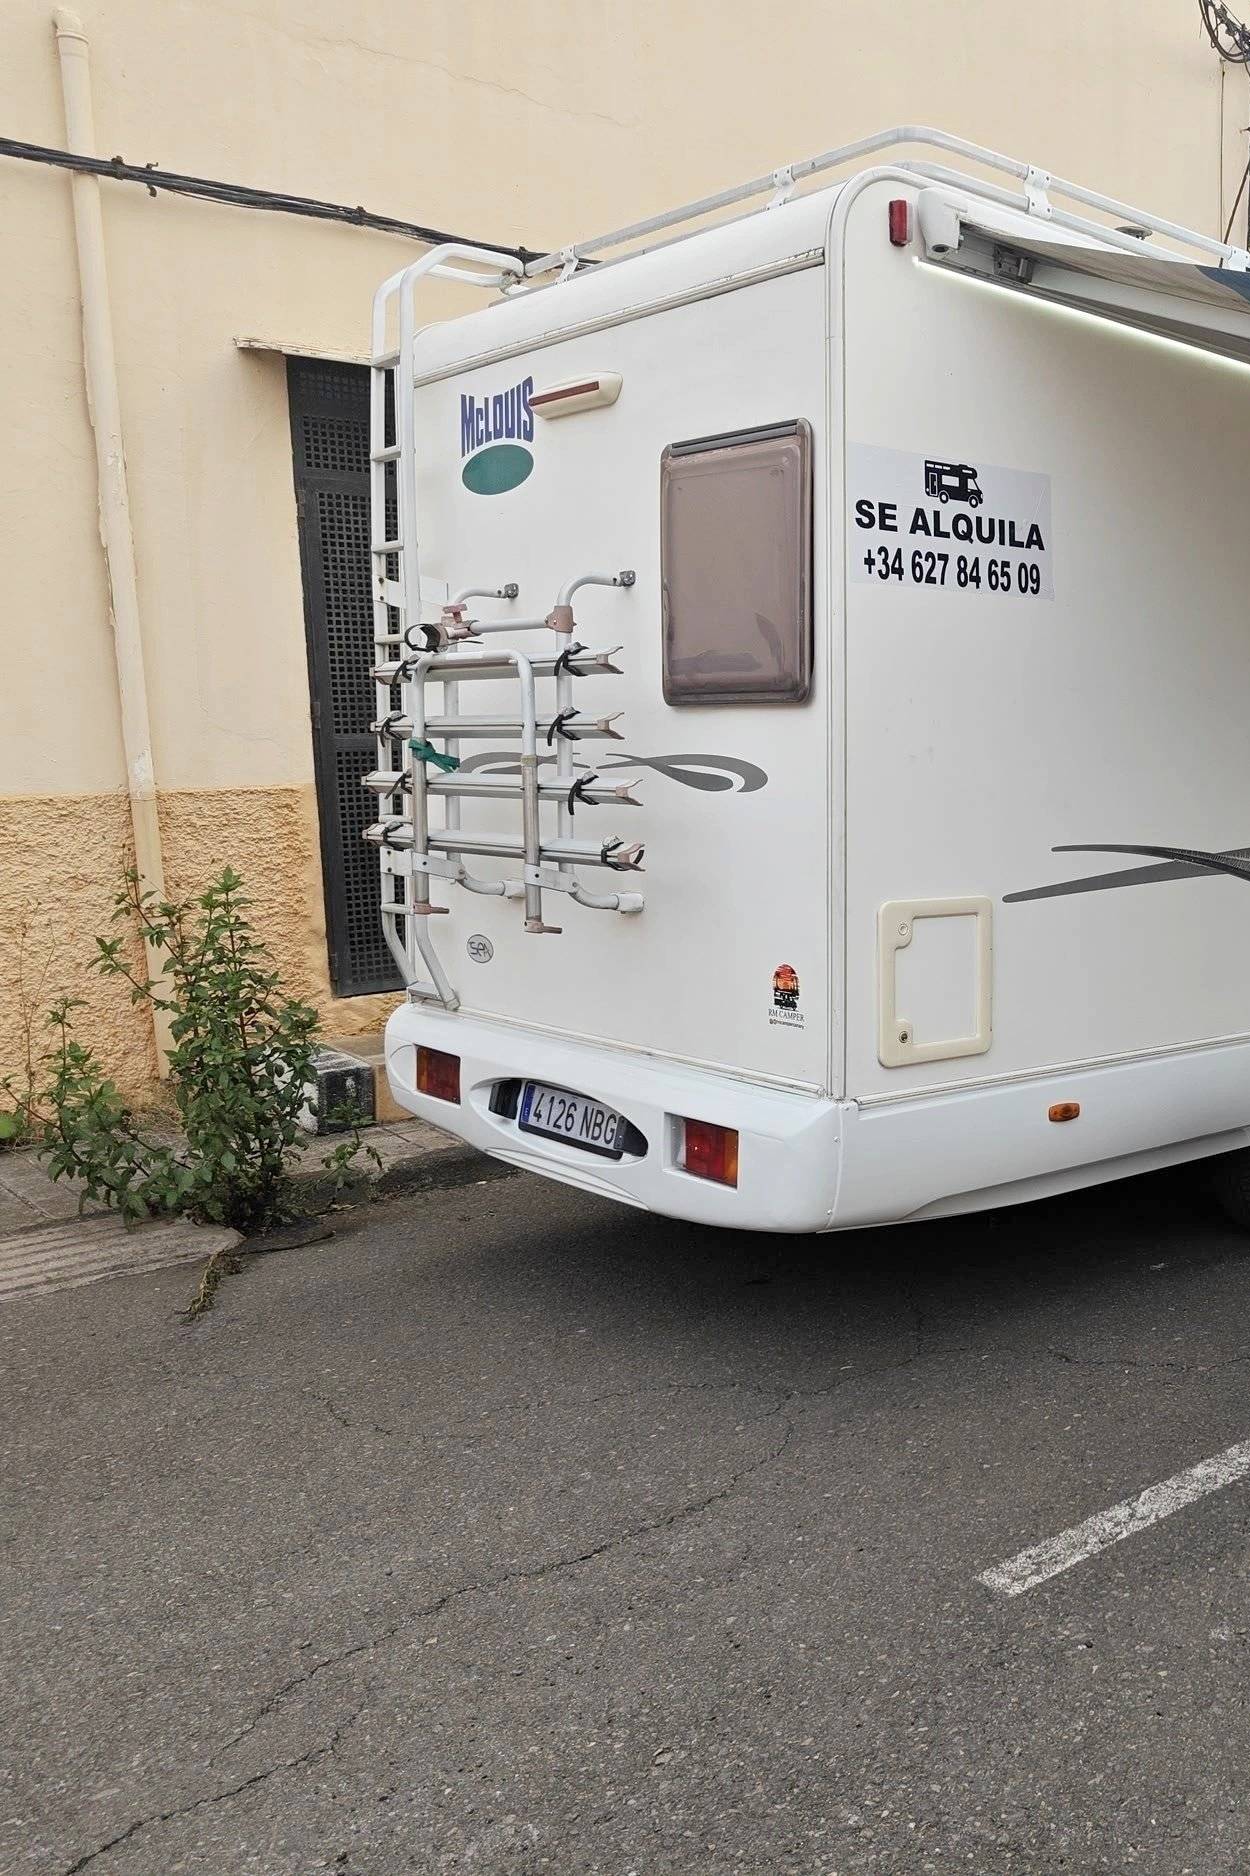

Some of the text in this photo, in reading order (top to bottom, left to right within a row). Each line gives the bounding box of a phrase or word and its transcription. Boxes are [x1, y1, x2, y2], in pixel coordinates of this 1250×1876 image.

[855, 499, 1046, 551] SE ALQUILA
[863, 546, 1041, 595] +34 627 84 65 09
[768, 1008, 805, 1022] RM CAMPER
[533, 1093, 617, 1145] 4126 NBG
